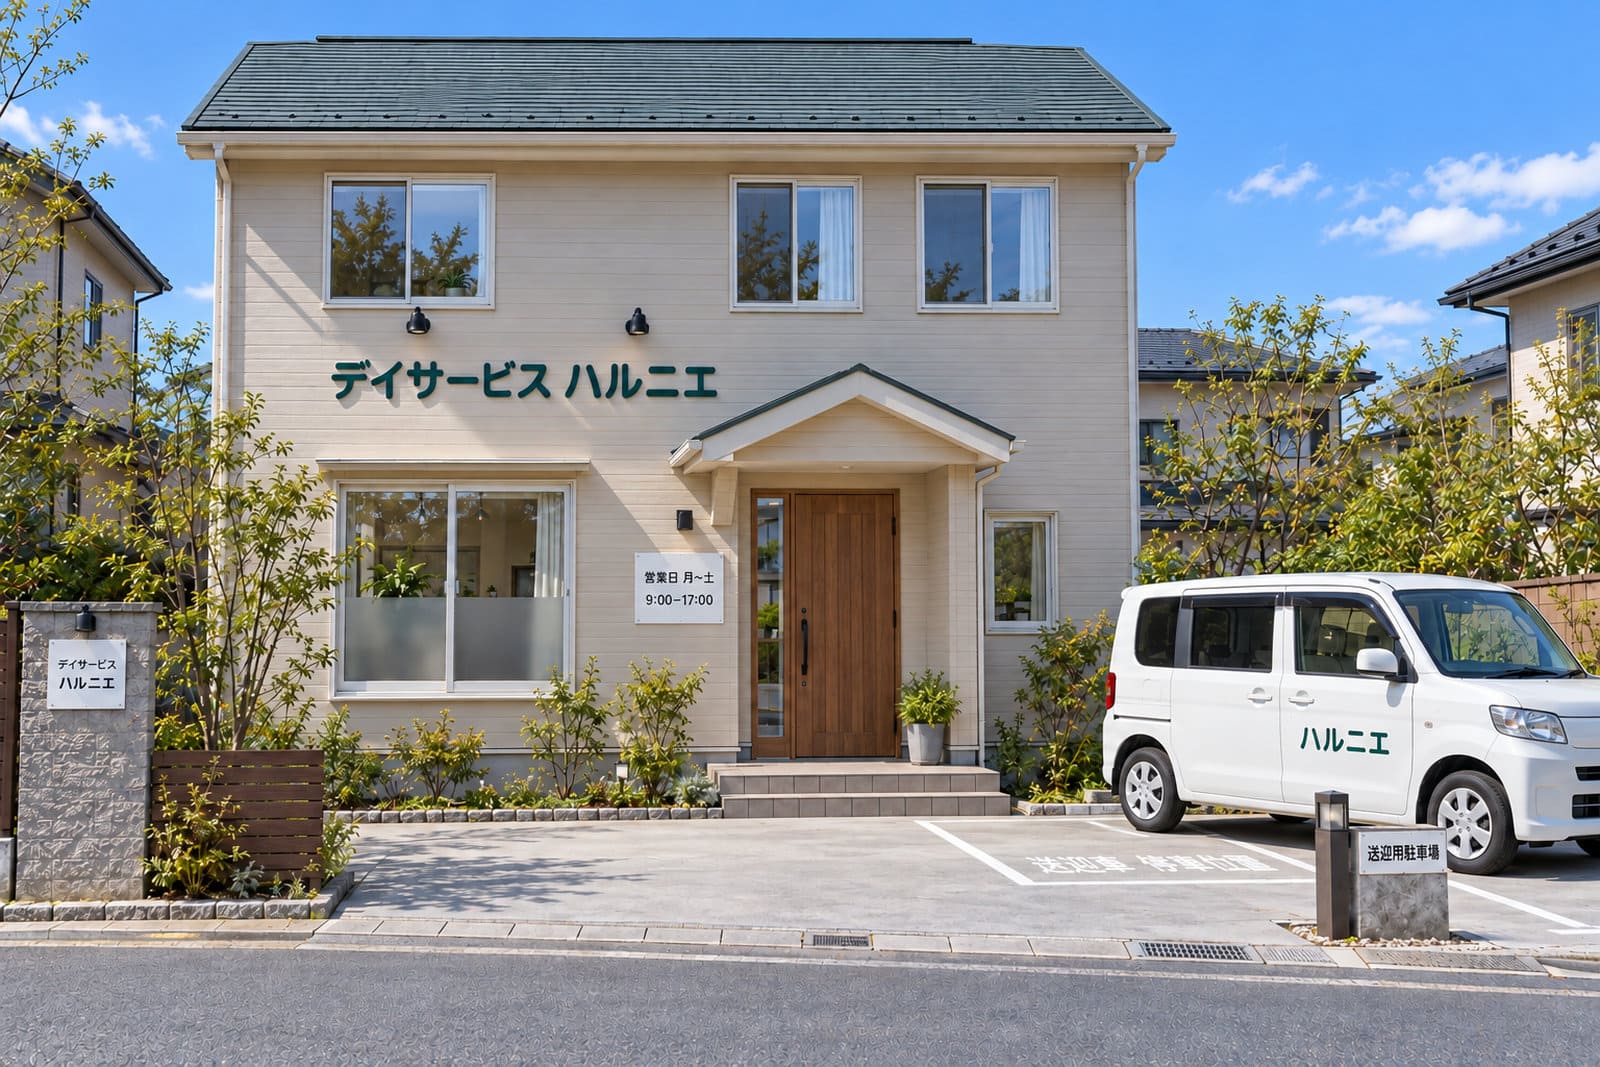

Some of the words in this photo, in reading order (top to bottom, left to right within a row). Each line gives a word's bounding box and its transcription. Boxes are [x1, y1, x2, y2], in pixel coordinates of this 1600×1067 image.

[331, 359, 551, 400] デイサービス
[565, 363, 718, 399] ハルニエ
[644, 571, 678, 584] 営業日
[59, 676, 116, 690] ハルニエ
[1300, 727, 1390, 756] ハルニエ
[1367, 843, 1440, 862] 送迎用駐車場
